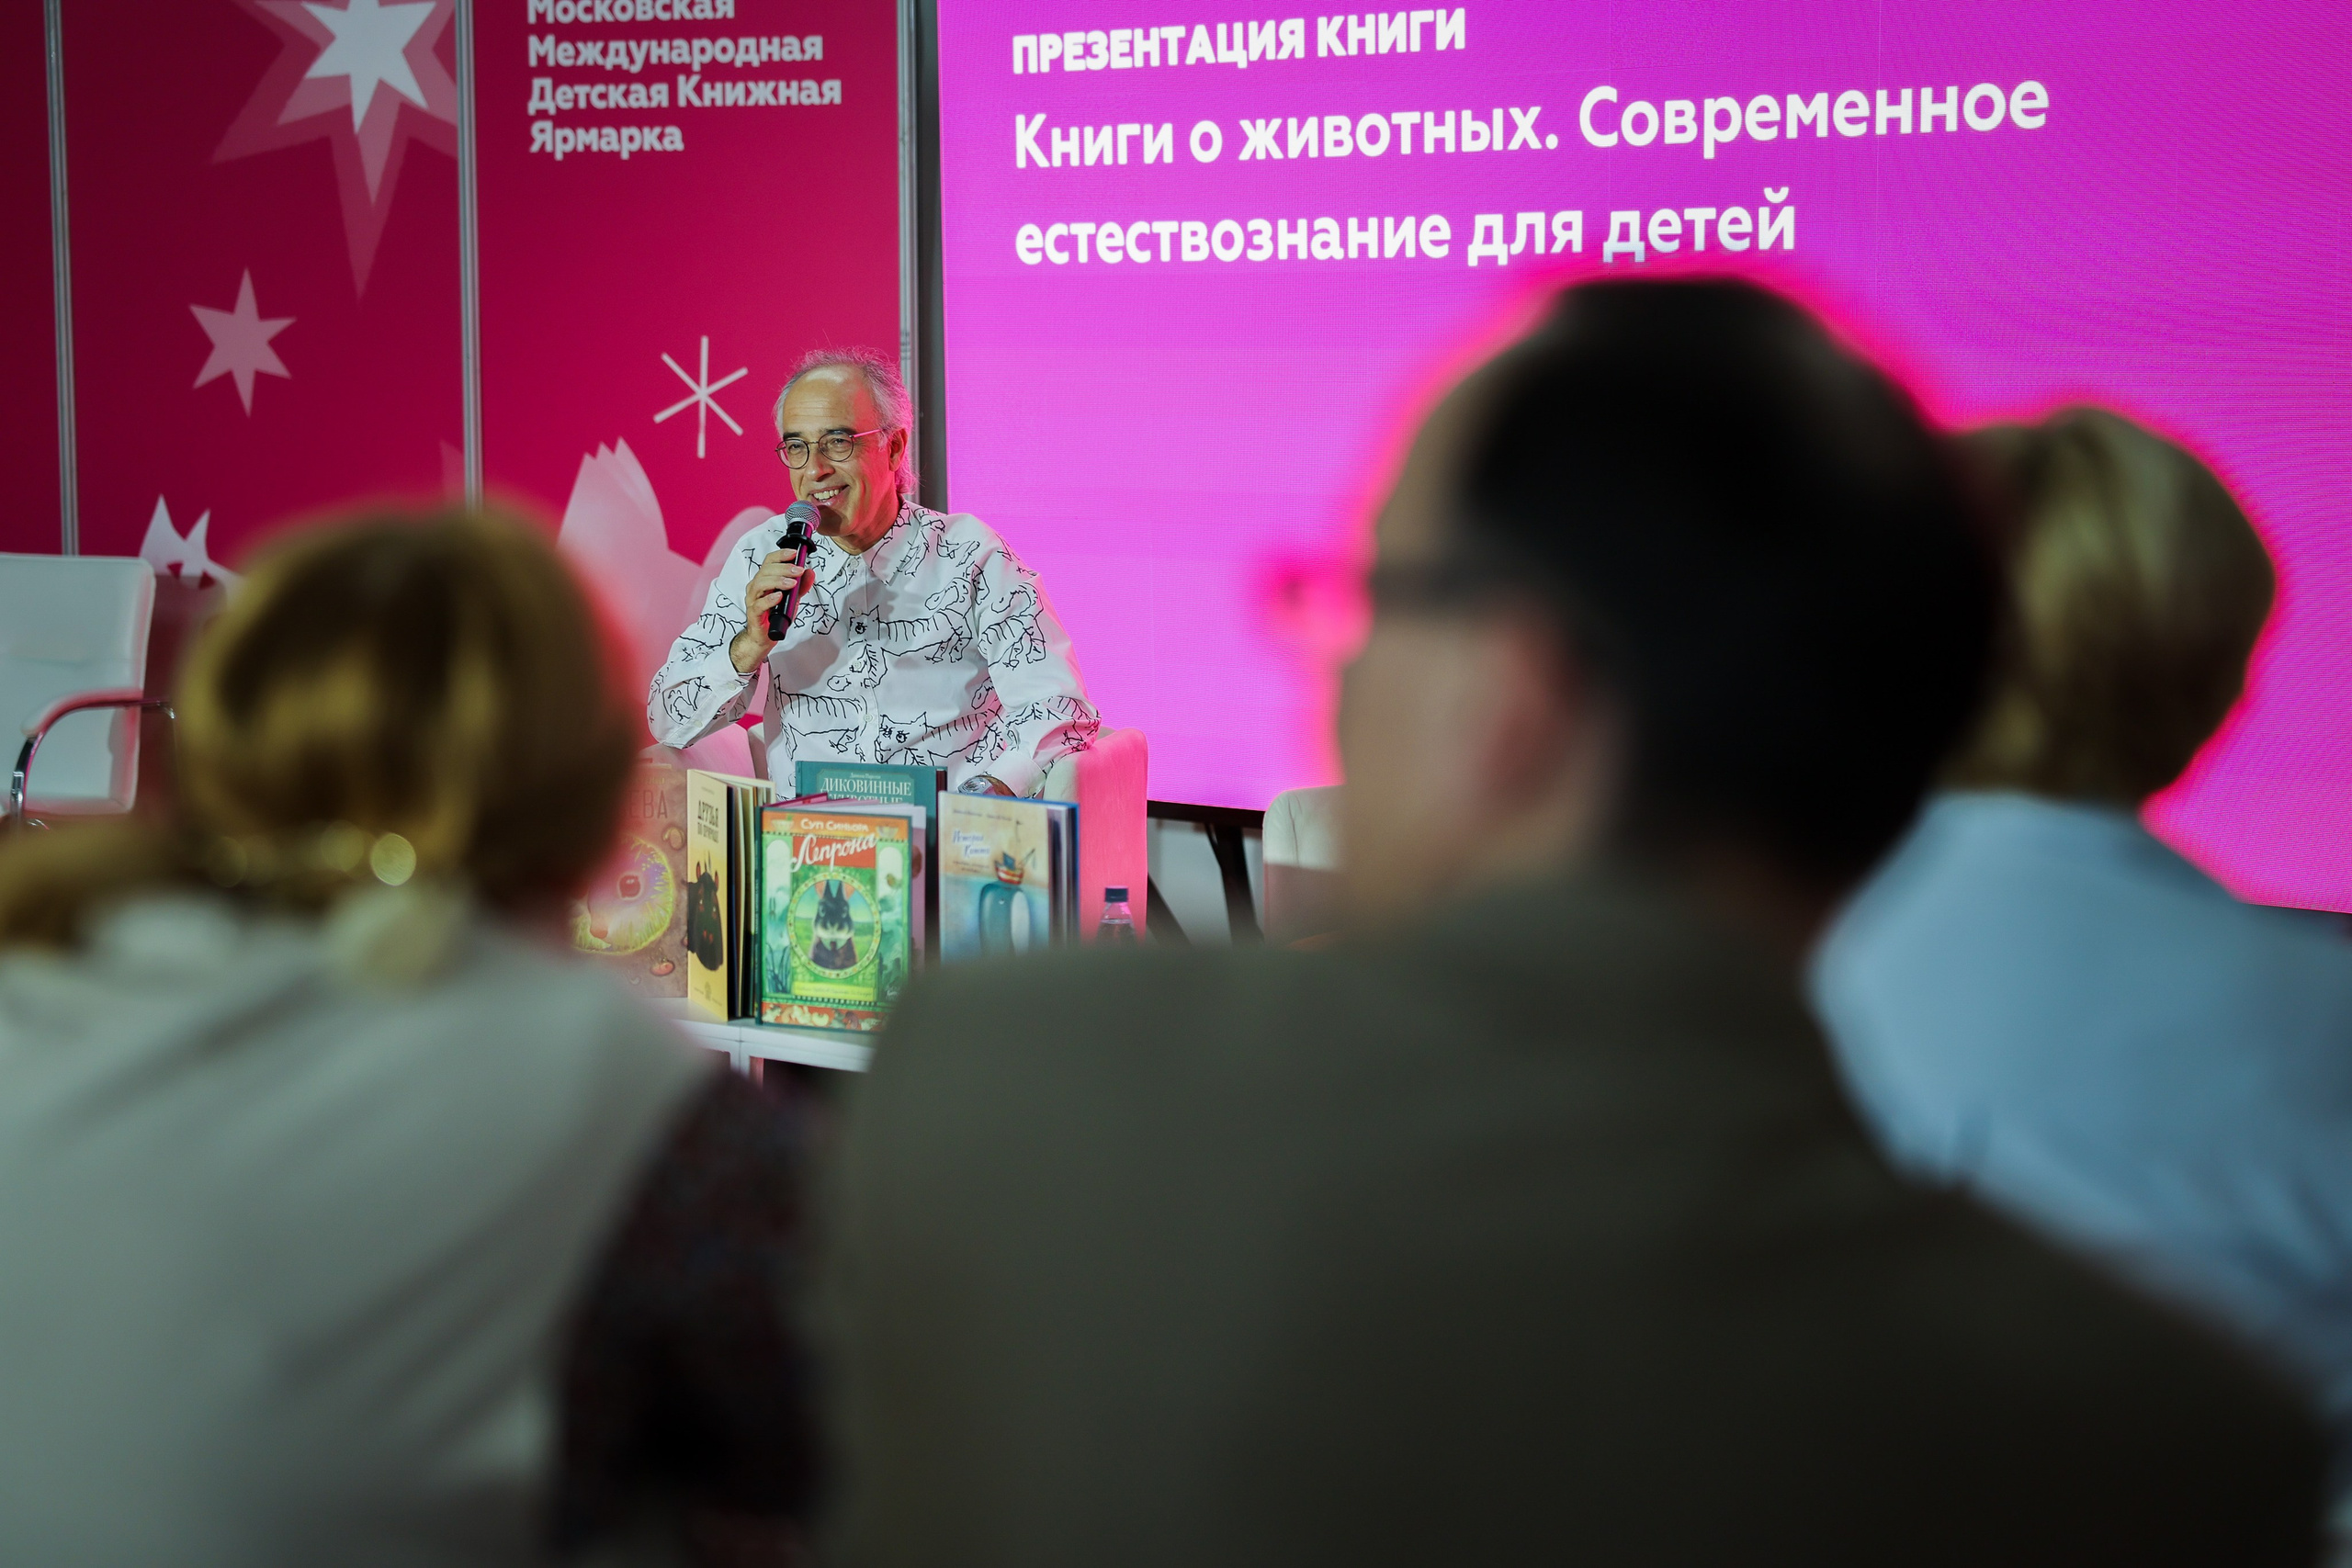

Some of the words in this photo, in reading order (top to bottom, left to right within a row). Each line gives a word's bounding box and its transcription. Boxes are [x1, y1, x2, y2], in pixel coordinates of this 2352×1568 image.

[527, 0, 735, 24] Московская
[527, 34, 823, 73] Международная
[1012, 17, 1306, 74] ПРЕЗЕНТАЦИЯ
[1317, 6, 1466, 58] КНИГИ
[527, 77, 670, 116] Детская
[677, 73, 842, 107] Книжная
[529, 119, 684, 161] Ярмарка
[1015, 113, 1174, 169] Книги
[1189, 119, 1224, 164] о
[1238, 106, 1559, 162] животных.
[1578, 80, 2050, 160] Современное
[1014, 213, 1452, 265] естествознание
[1467, 209, 1583, 267] для
[1602, 186, 1795, 263] детей
[820, 777, 912, 796] ДИКОВИННЫЕ
